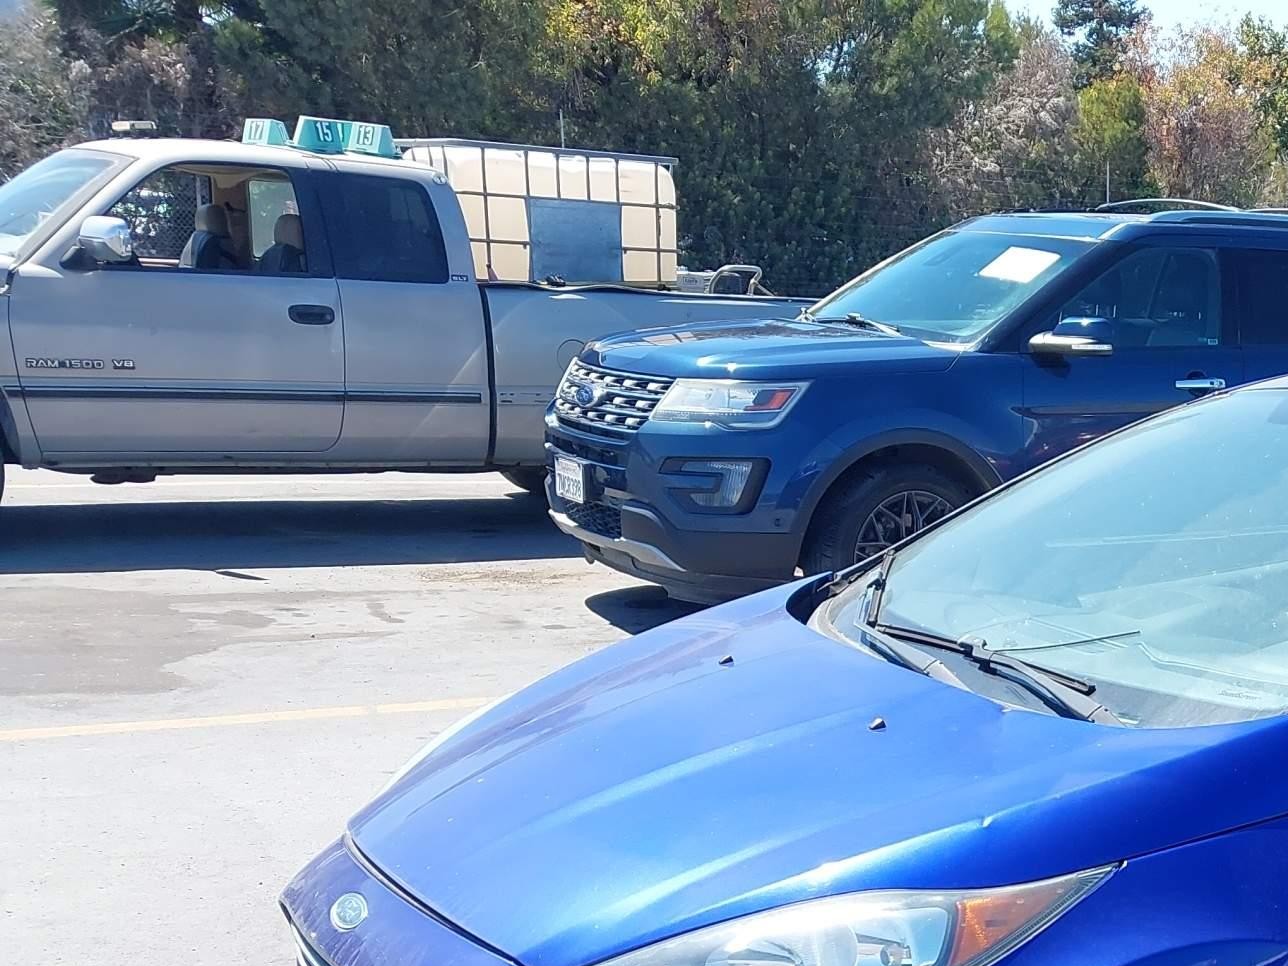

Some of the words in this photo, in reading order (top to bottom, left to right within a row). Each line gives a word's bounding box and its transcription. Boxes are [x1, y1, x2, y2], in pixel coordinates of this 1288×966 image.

[250, 121, 264, 139] 17
[315, 122, 332, 142] 15
[358, 125, 374, 145] 13
[25, 357, 59, 368] RAM
[64, 359, 104, 369] 1500
[112, 359, 135, 369] V8
